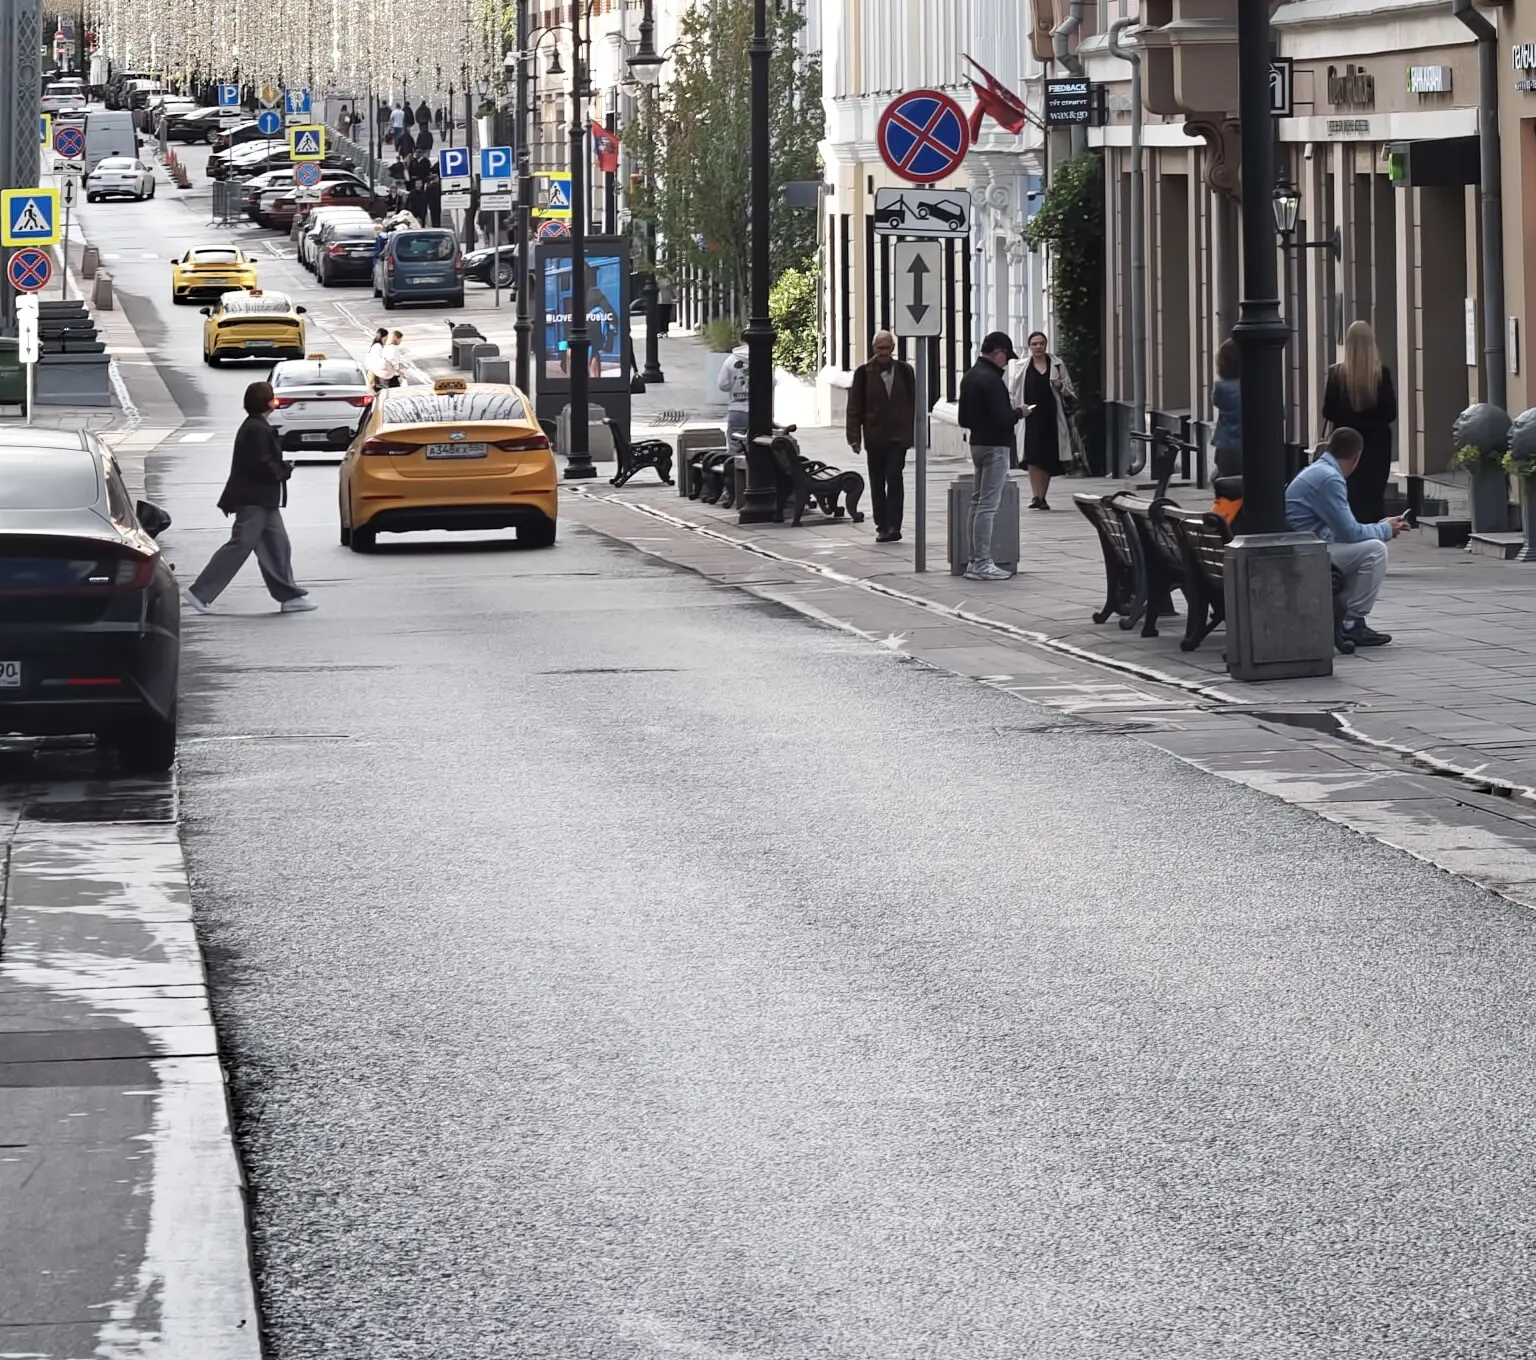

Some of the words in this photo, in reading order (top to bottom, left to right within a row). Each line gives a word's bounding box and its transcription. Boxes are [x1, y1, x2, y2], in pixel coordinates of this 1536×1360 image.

[224, 86, 237, 103] P
[445, 151, 463, 175] P
[488, 150, 506, 176] P
[585, 313, 613, 321] PUBLIC
